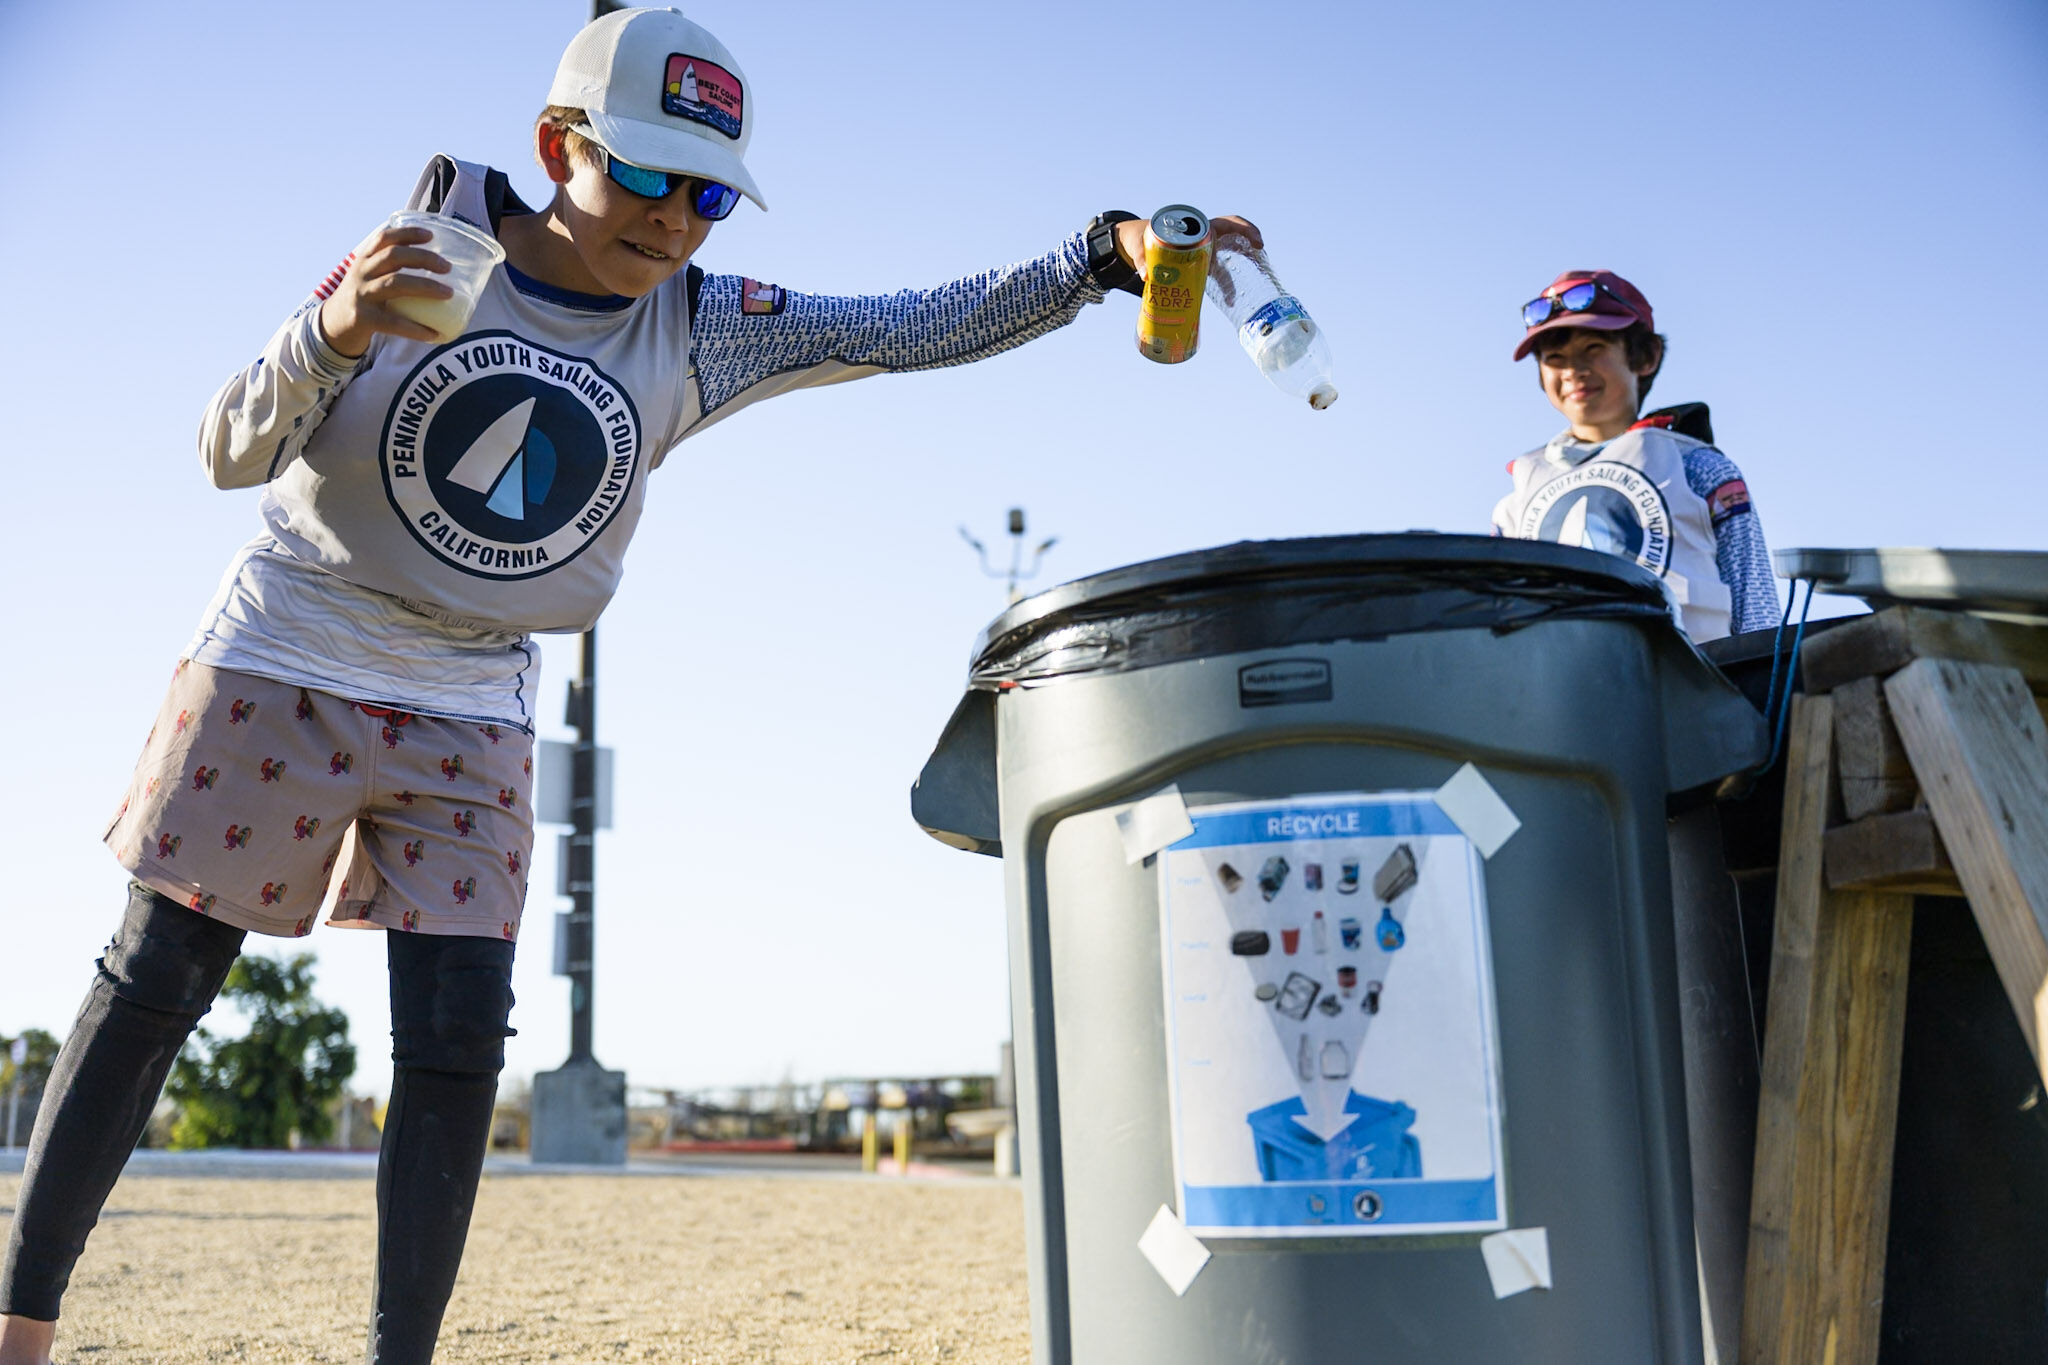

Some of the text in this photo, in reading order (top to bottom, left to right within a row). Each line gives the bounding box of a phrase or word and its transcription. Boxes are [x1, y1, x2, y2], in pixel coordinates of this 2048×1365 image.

[708, 91, 734, 109] SAILING
[1147, 296, 1194, 309] ADRE
[1149, 284, 1191, 298] ERBA
[393, 343, 633, 536] PENINSULA YOUTH SAILING FOUNDATION
[1541, 471, 1584, 504] YOUTH
[1587, 467, 1639, 492] SAILING
[418, 510, 549, 569] CALIFORNIA
[1267, 812, 1361, 836] RECYCLE
